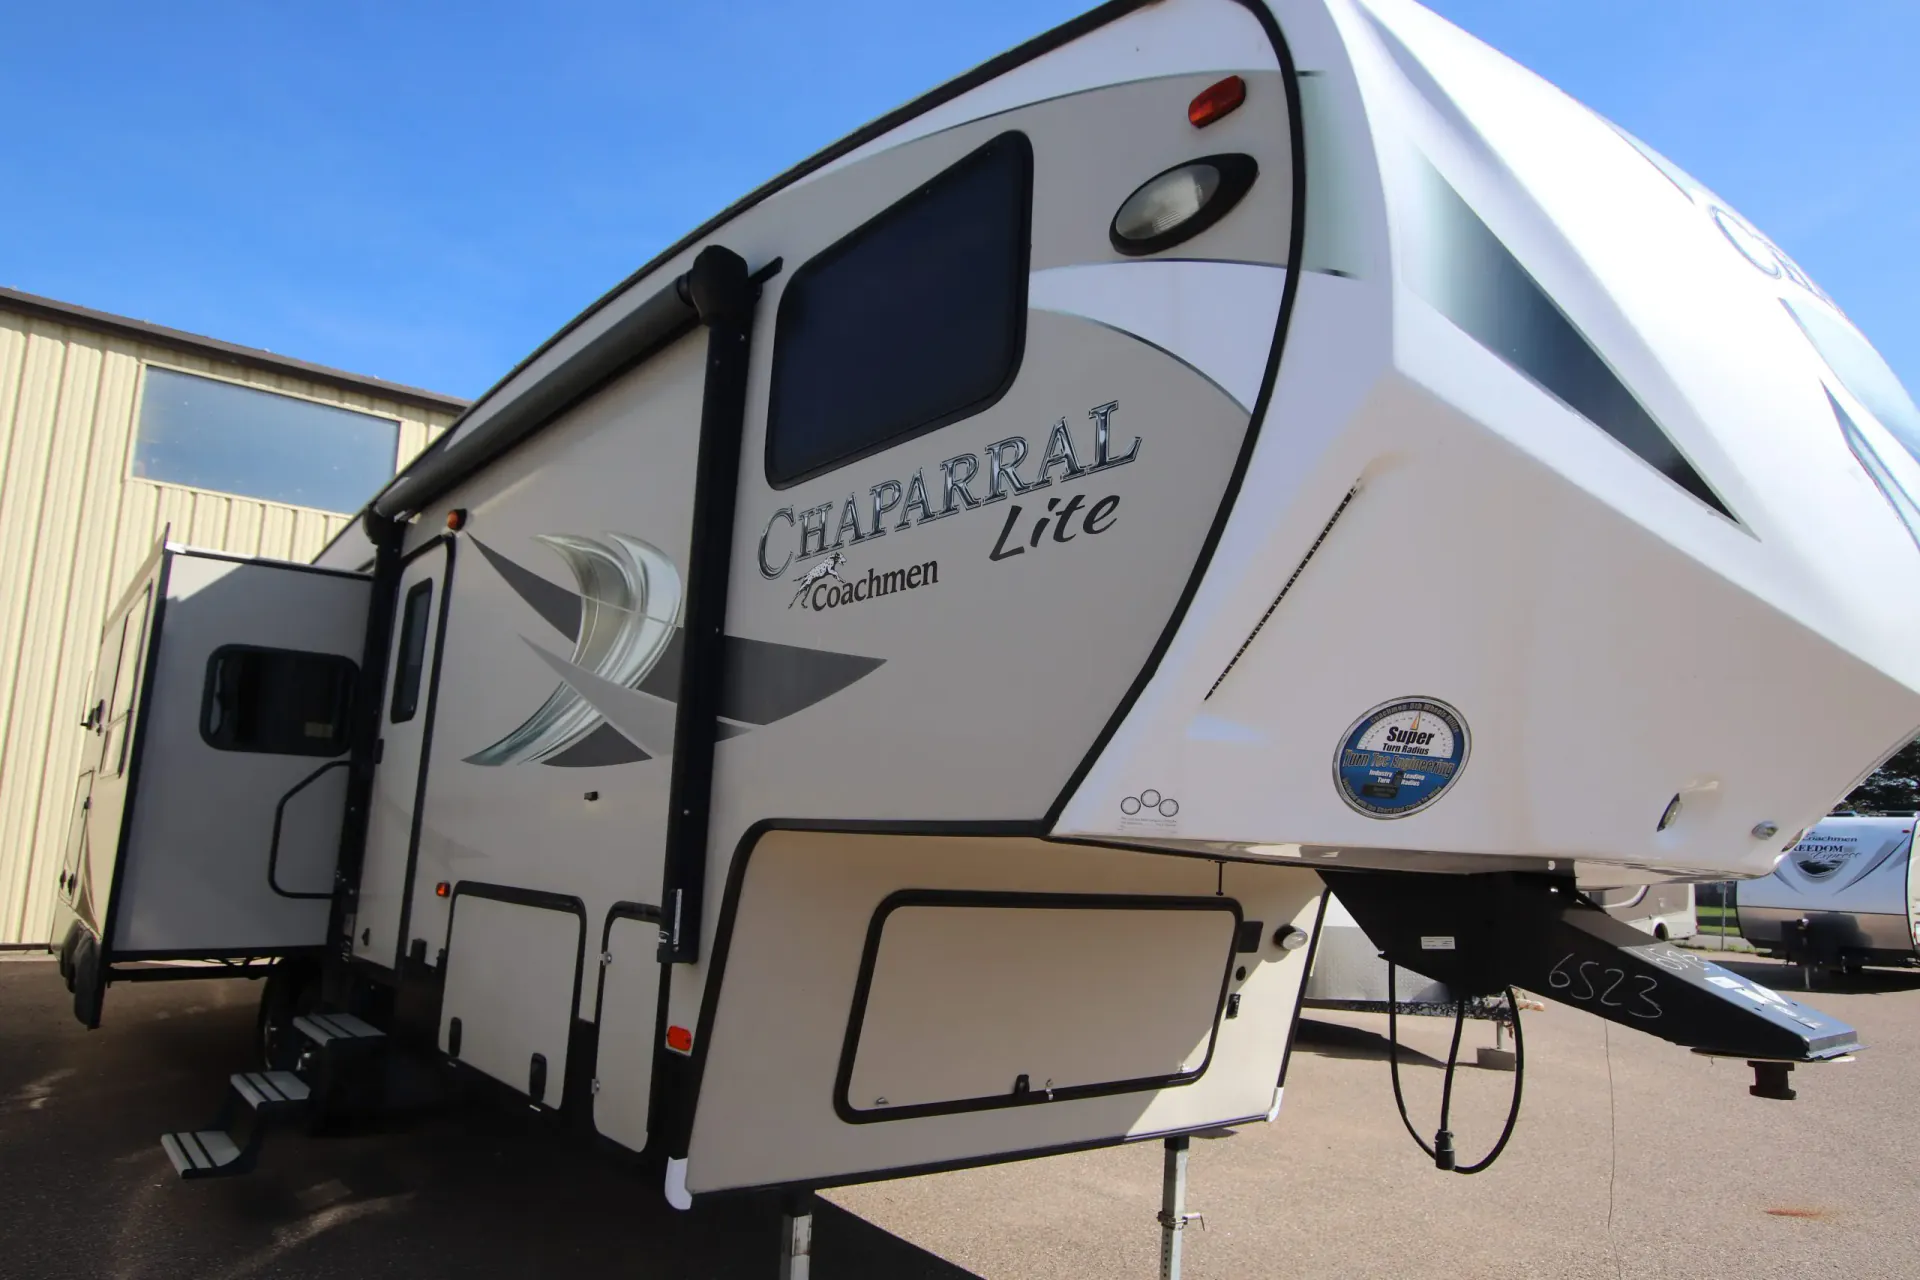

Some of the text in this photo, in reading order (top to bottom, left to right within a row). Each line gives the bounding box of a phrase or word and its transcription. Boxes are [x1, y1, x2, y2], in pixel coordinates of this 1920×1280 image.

[758, 400, 1143, 580] CHAPARRAL
[989, 494, 1121, 562] Lite
[812, 560, 939, 612] Coachmen
[1383, 743, 1429, 755] Turn Radius
[1387, 726, 1435, 745] Super
[1343, 749, 1368, 767] Turn
[1392, 755, 1455, 778] Engineering
[1369, 770, 1425, 781] Industry Leading
[1549, 953, 1663, 1018] 6523
